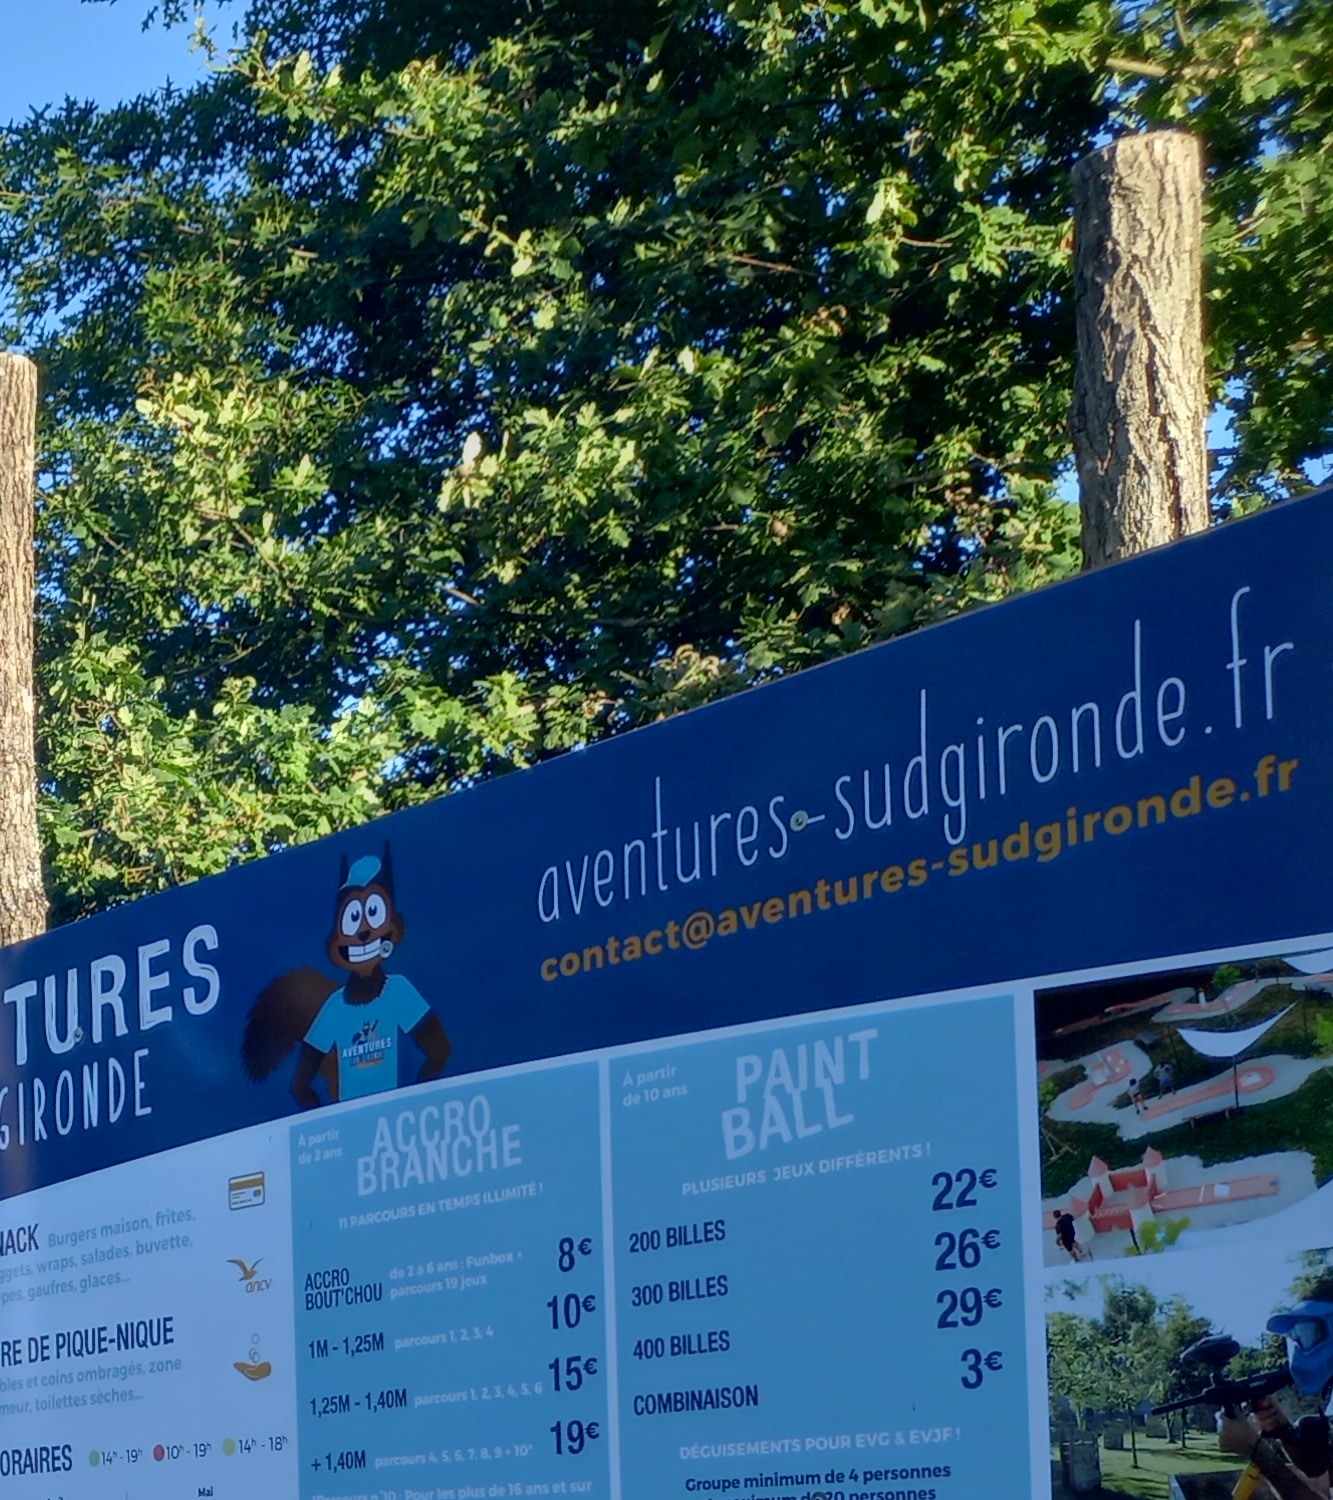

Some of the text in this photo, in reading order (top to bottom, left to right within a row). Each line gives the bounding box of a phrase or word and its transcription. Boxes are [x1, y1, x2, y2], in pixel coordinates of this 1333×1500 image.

[538, 587, 1294, 923] aventures-sudgironde.fr
[540, 755, 1298, 983] contact@aventures-sudgironde.fr
[342, 1037, 391, 1057] AVENTURES
[736, 1029, 878, 1103] PAINT
[371, 1095, 491, 1158] ACCRO
[722, 1076, 854, 1160] BALL
[357, 1124, 522, 1196] BRANCHE
[682, 1144, 922, 1197] PLUSIEURS JEUX DIFFÉRENTS
[932, 1168, 997, 1211] 22€
[351, 1194, 480, 1227] PARCOURS TEMPS
[49, 1226, 96, 1249] Burgers
[101, 1217, 152, 1238] maison,
[156, 1208, 196, 1227] frites,
[629, 1220, 725, 1253] 200 BILLES
[467, 1251, 513, 1268] Funbox
[558, 1237, 592, 1272] 8€
[934, 1229, 1001, 1271] 26€
[305, 1268, 349, 1292] ACCRO
[306, 1282, 382, 1311] BOUT'CHOU
[632, 1275, 728, 1306] 300 BILLES
[548, 1294, 596, 1329] 10€
[937, 1288, 1002, 1329] 29€
[29, 1335, 50, 1364] DE
[56, 1317, 174, 1358] PIQUE-NIQUE
[309, 1332, 384, 1358] 1M 1,25M
[633, 1330, 730, 1360] 400 BILLES
[42, 1358, 182, 1387] coins zone
[549, 1356, 598, 1392] 15€
[961, 1349, 1003, 1390] 3€
[36, 1394, 87, 1411] toilettes
[310, 1388, 407, 1418] 1,25M 1,40M
[634, 1384, 759, 1416] COMBINAISON
[551, 1420, 599, 1455] 19€
[680, 1436, 851, 1459] DÉGUISEMENTS POUR
[325, 1451, 366, 1473] 1,40M
[686, 1465, 951, 1494] Groupe minimum de personnes
